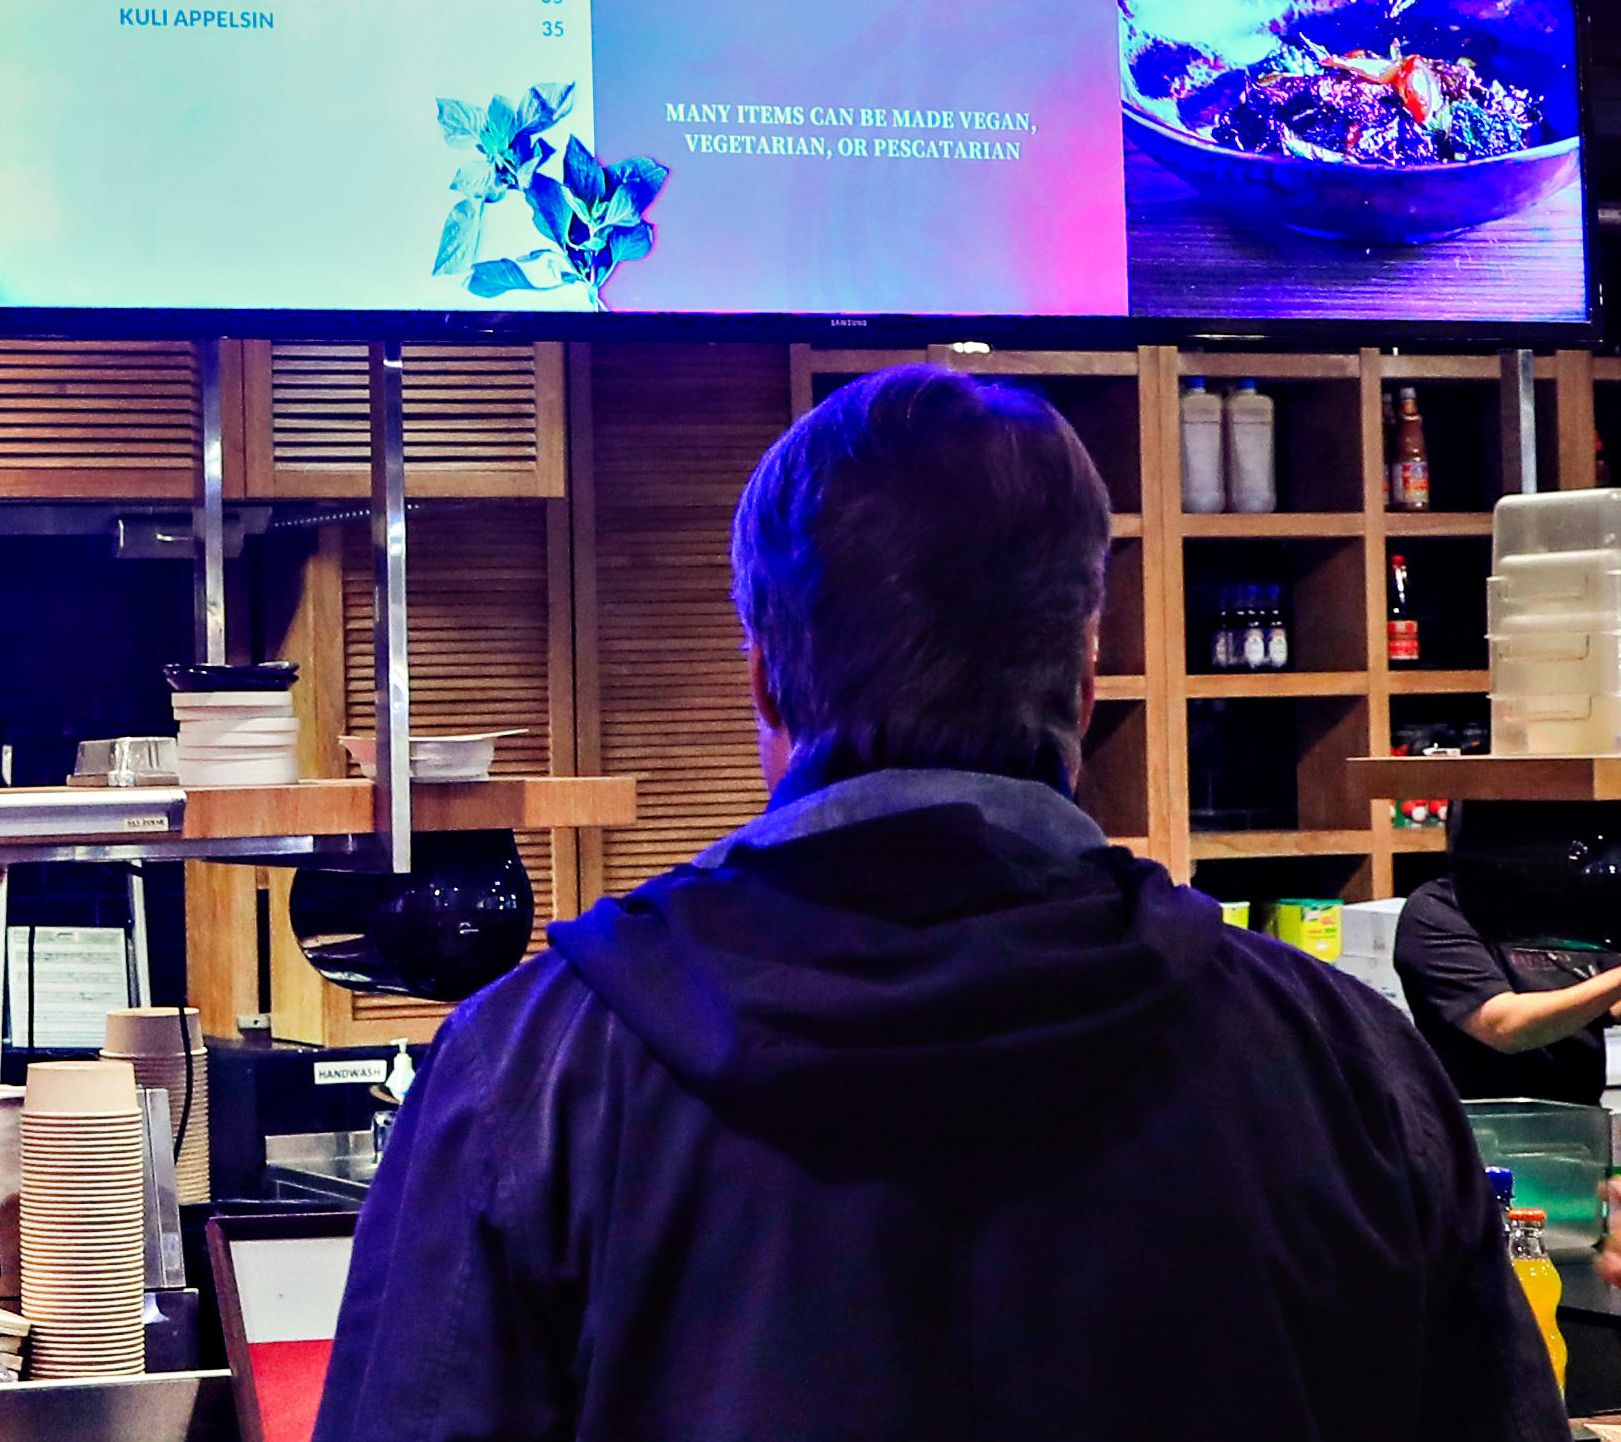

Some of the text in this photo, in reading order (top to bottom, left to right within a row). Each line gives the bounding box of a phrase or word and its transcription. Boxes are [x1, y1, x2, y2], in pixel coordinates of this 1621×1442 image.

[120, 8, 564, 37] KULI APPELSIN 35
[666, 104, 1036, 135] MANY ITEMS CAN BE MADE VEGAN,
[686, 135, 1021, 159] VEGETARIAN, OR PESCATARIAN
[318, 1068, 381, 1080] HANDWASH
